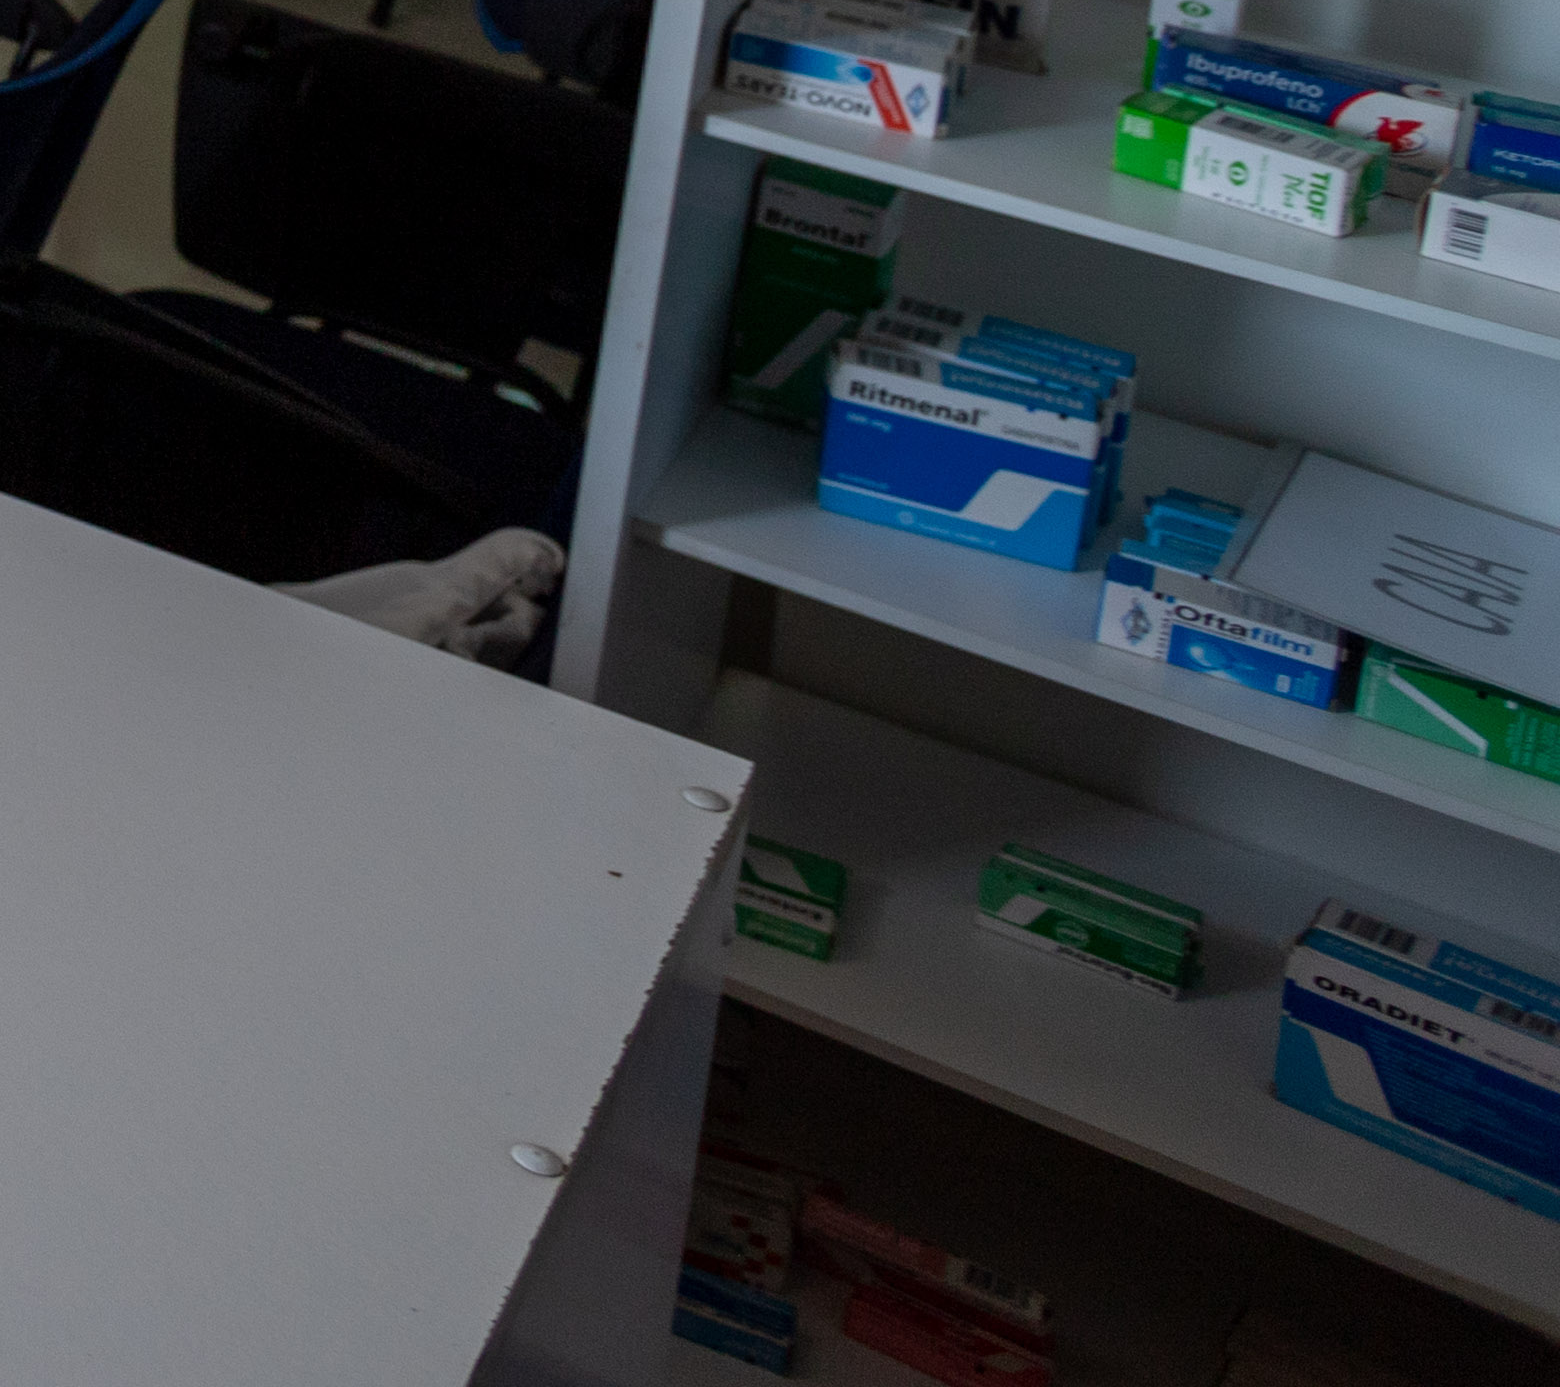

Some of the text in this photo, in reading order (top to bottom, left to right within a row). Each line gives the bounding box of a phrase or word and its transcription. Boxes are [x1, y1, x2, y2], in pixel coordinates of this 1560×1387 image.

[1186, 53, 1324, 99] Ibuprofeno
[1307, 172, 1333, 221] TIOF
[848, 380, 980, 426] Ritmenal
[1373, 534, 1529, 636] CAJA
[1174, 604, 1314, 658] Oftafilm
[1314, 974, 1467, 1044] ORADIET
